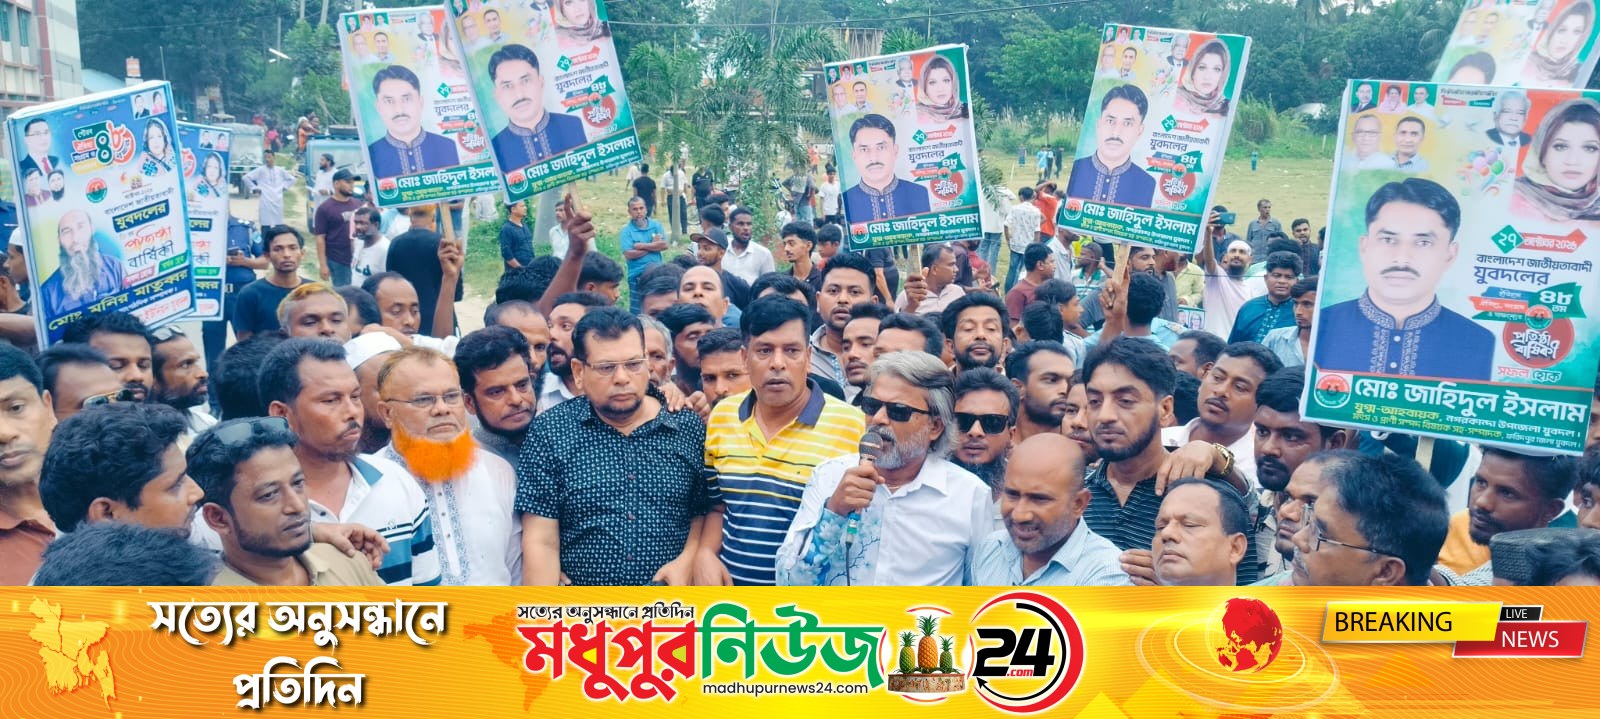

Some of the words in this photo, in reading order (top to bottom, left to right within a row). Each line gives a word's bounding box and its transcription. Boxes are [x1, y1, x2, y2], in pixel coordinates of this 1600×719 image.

[1150, 138, 1188, 152] যুবদলের
[527, 162, 549, 179] মোঃ
[551, 148, 596, 167] জাহিদুল
[597, 136, 635, 156] ইসলাম
[908, 150, 945, 163] যুবদলের
[398, 178, 421, 189] মোঃ
[422, 169, 467, 186] জাহিদুল
[468, 166, 498, 180] ইসলা
[115, 203, 167, 230] যুবদলের
[869, 223, 890, 234] মোঃ
[892, 216, 938, 233] জাহিদুল
[939, 213, 979, 228] ইসলাম
[1084, 203, 1105, 217] মোঃ
[1107, 206, 1154, 230] জাহিদুল
[1154, 214, 1197, 236] ইসলাম
[1498, 231, 1517, 247] ২৭
[127, 239, 174, 268] বার্ষিকী
[1476, 253, 1525, 266] বাংলাদেশ
[1527, 257, 1593, 272] জাতীয়তাবাদী
[1473, 265, 1551, 286] যুবদলের
[88, 292, 130, 314] মনির
[1539, 290, 1573, 305] ৪৮
[1552, 305, 1567, 313] তম
[1531, 369, 1562, 383] হোক
[1354, 378, 1399, 400] মোঃ
[1404, 381, 1499, 418] জাহিদুল
[1503, 390, 1588, 423] ইসলাম
[1446, 414, 1496, 428] নগরকান্দা
[1498, 420, 1540, 433] উপজেলা
[1542, 426, 1575, 438] যুবদল
